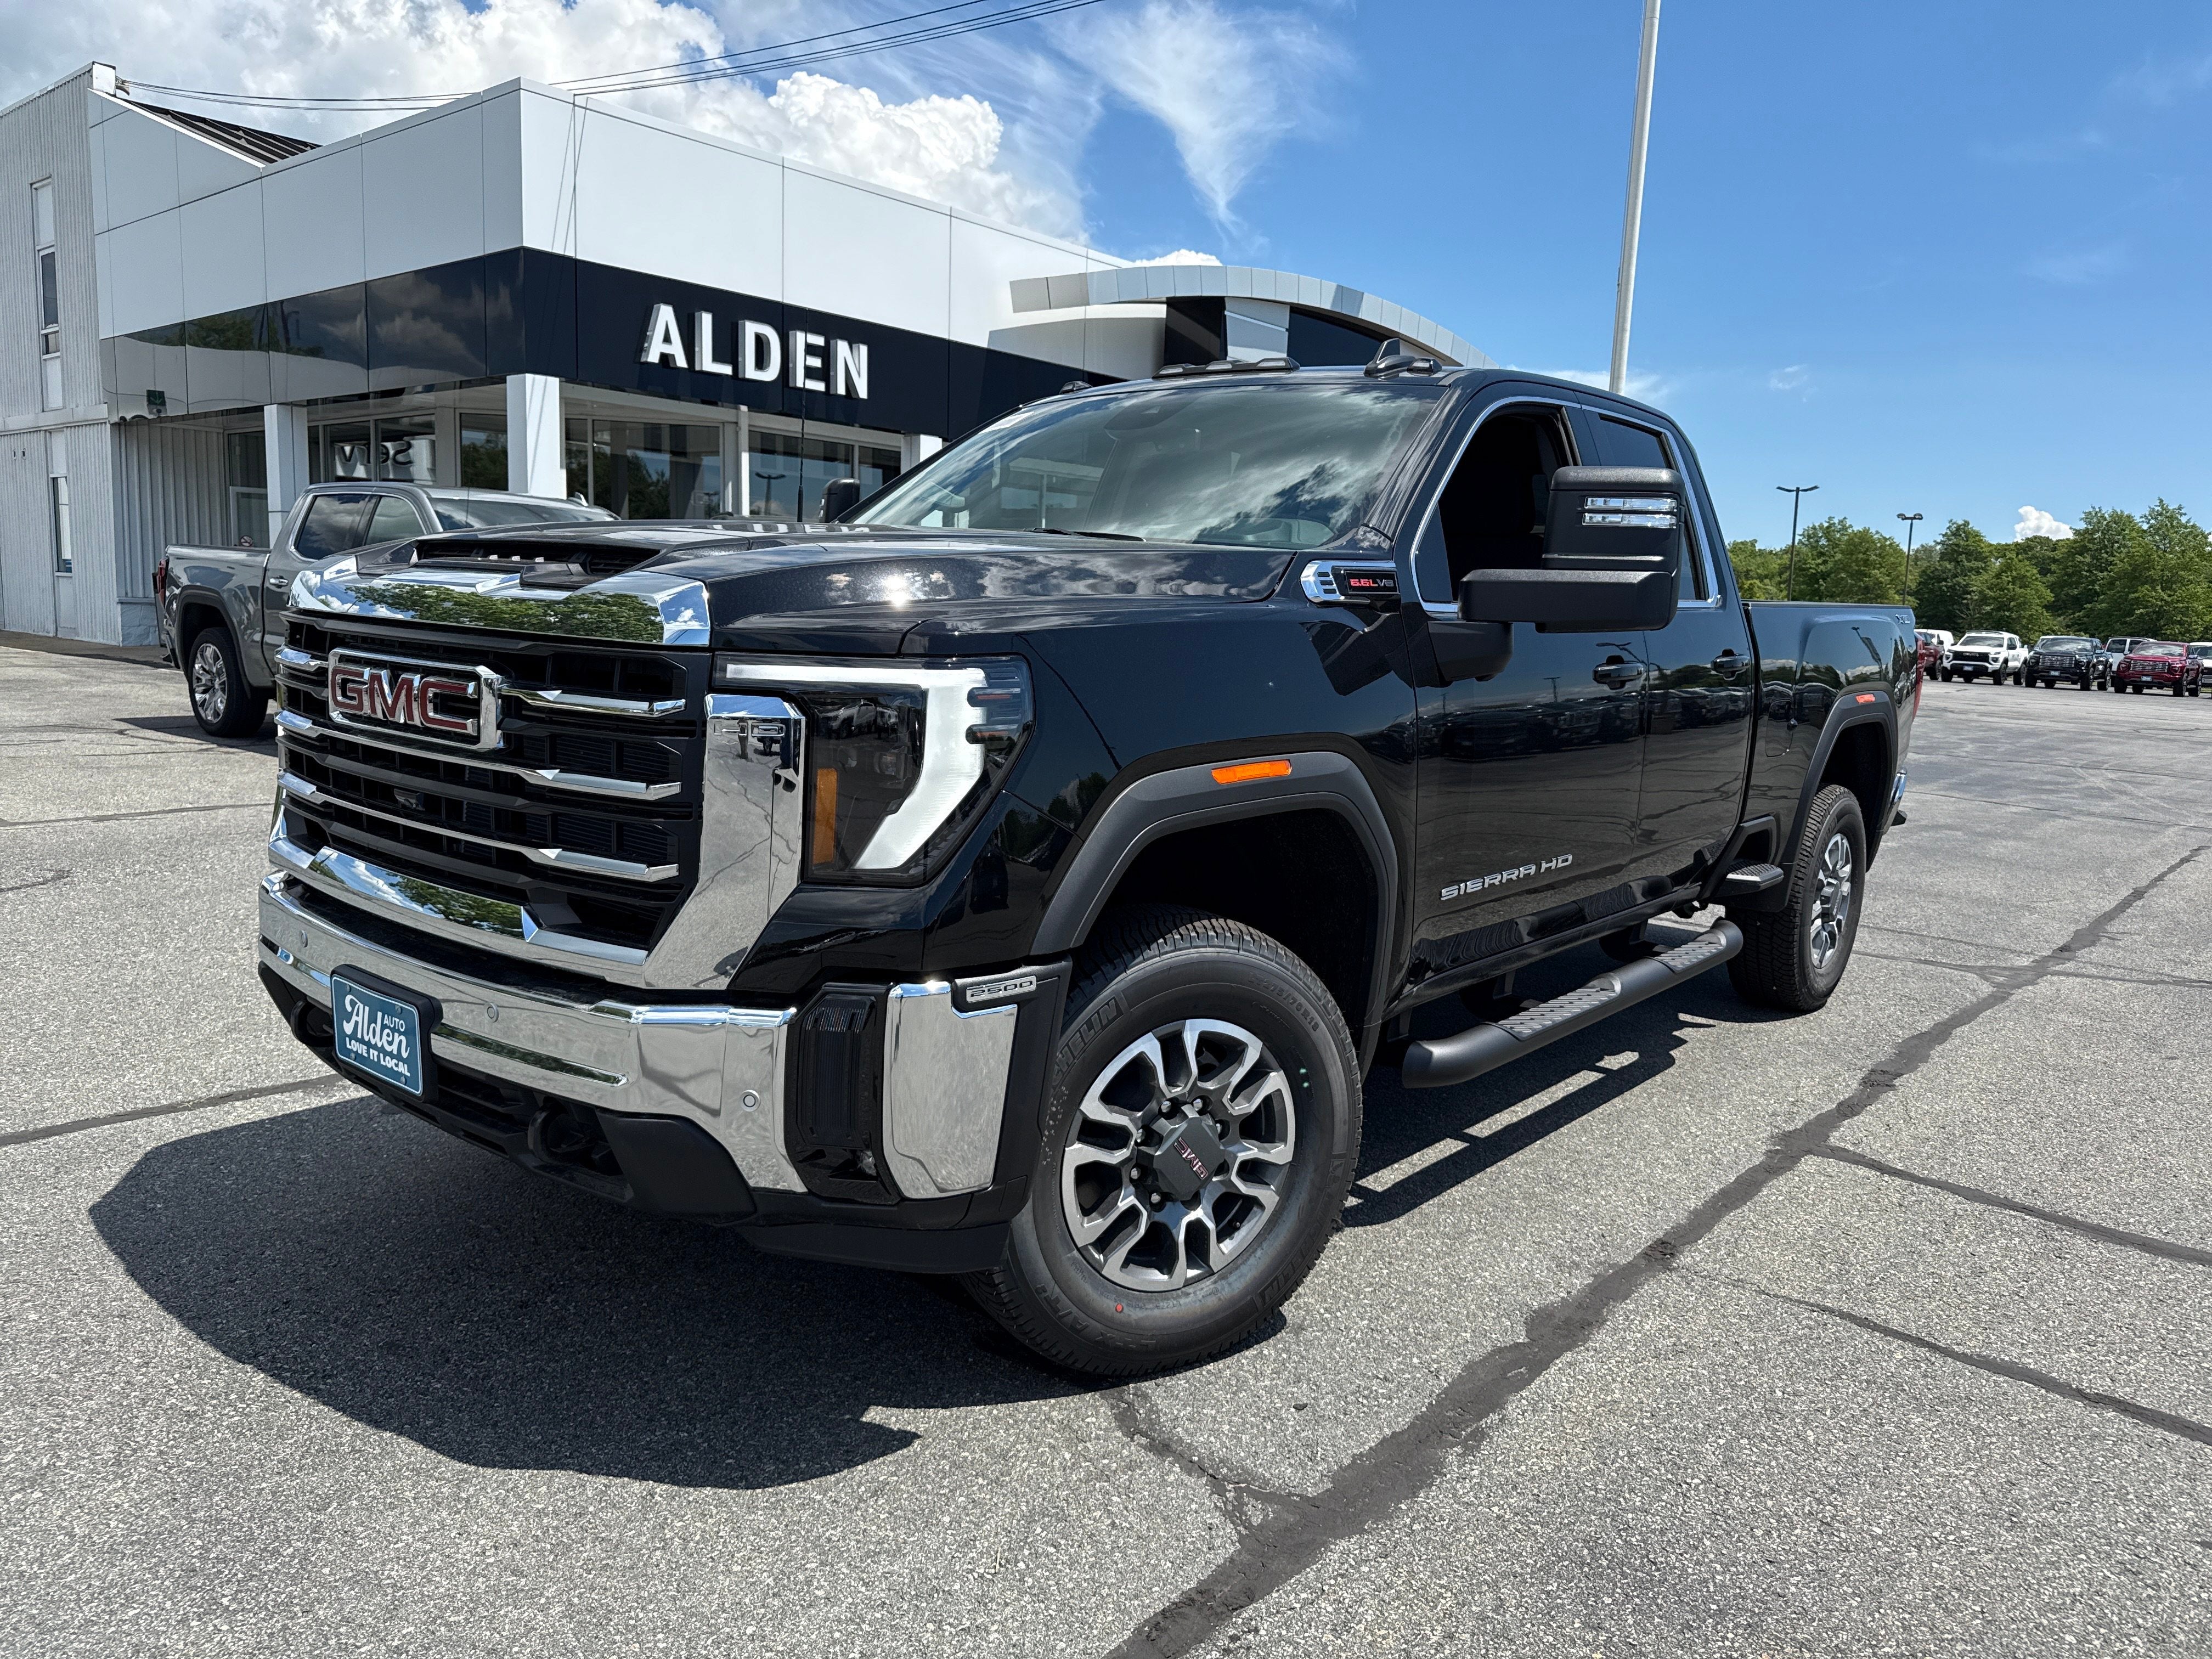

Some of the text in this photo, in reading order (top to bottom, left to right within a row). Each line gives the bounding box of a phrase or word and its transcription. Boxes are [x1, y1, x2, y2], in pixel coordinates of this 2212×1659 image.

[641, 303, 868, 399] ALDEN
[331, 663, 478, 736] GMC
[1440, 854, 1573, 900] SIERRA HD
[970, 980, 1033, 997] 2500
[343, 994, 410, 1058] Alden
[383, 1014, 405, 1031] AUTO
[1052, 998, 1118, 1085] CHELIN
[346, 1037, 410, 1076] LOVE IT LOCAL
[1173, 1137, 1208, 1180] GMC
